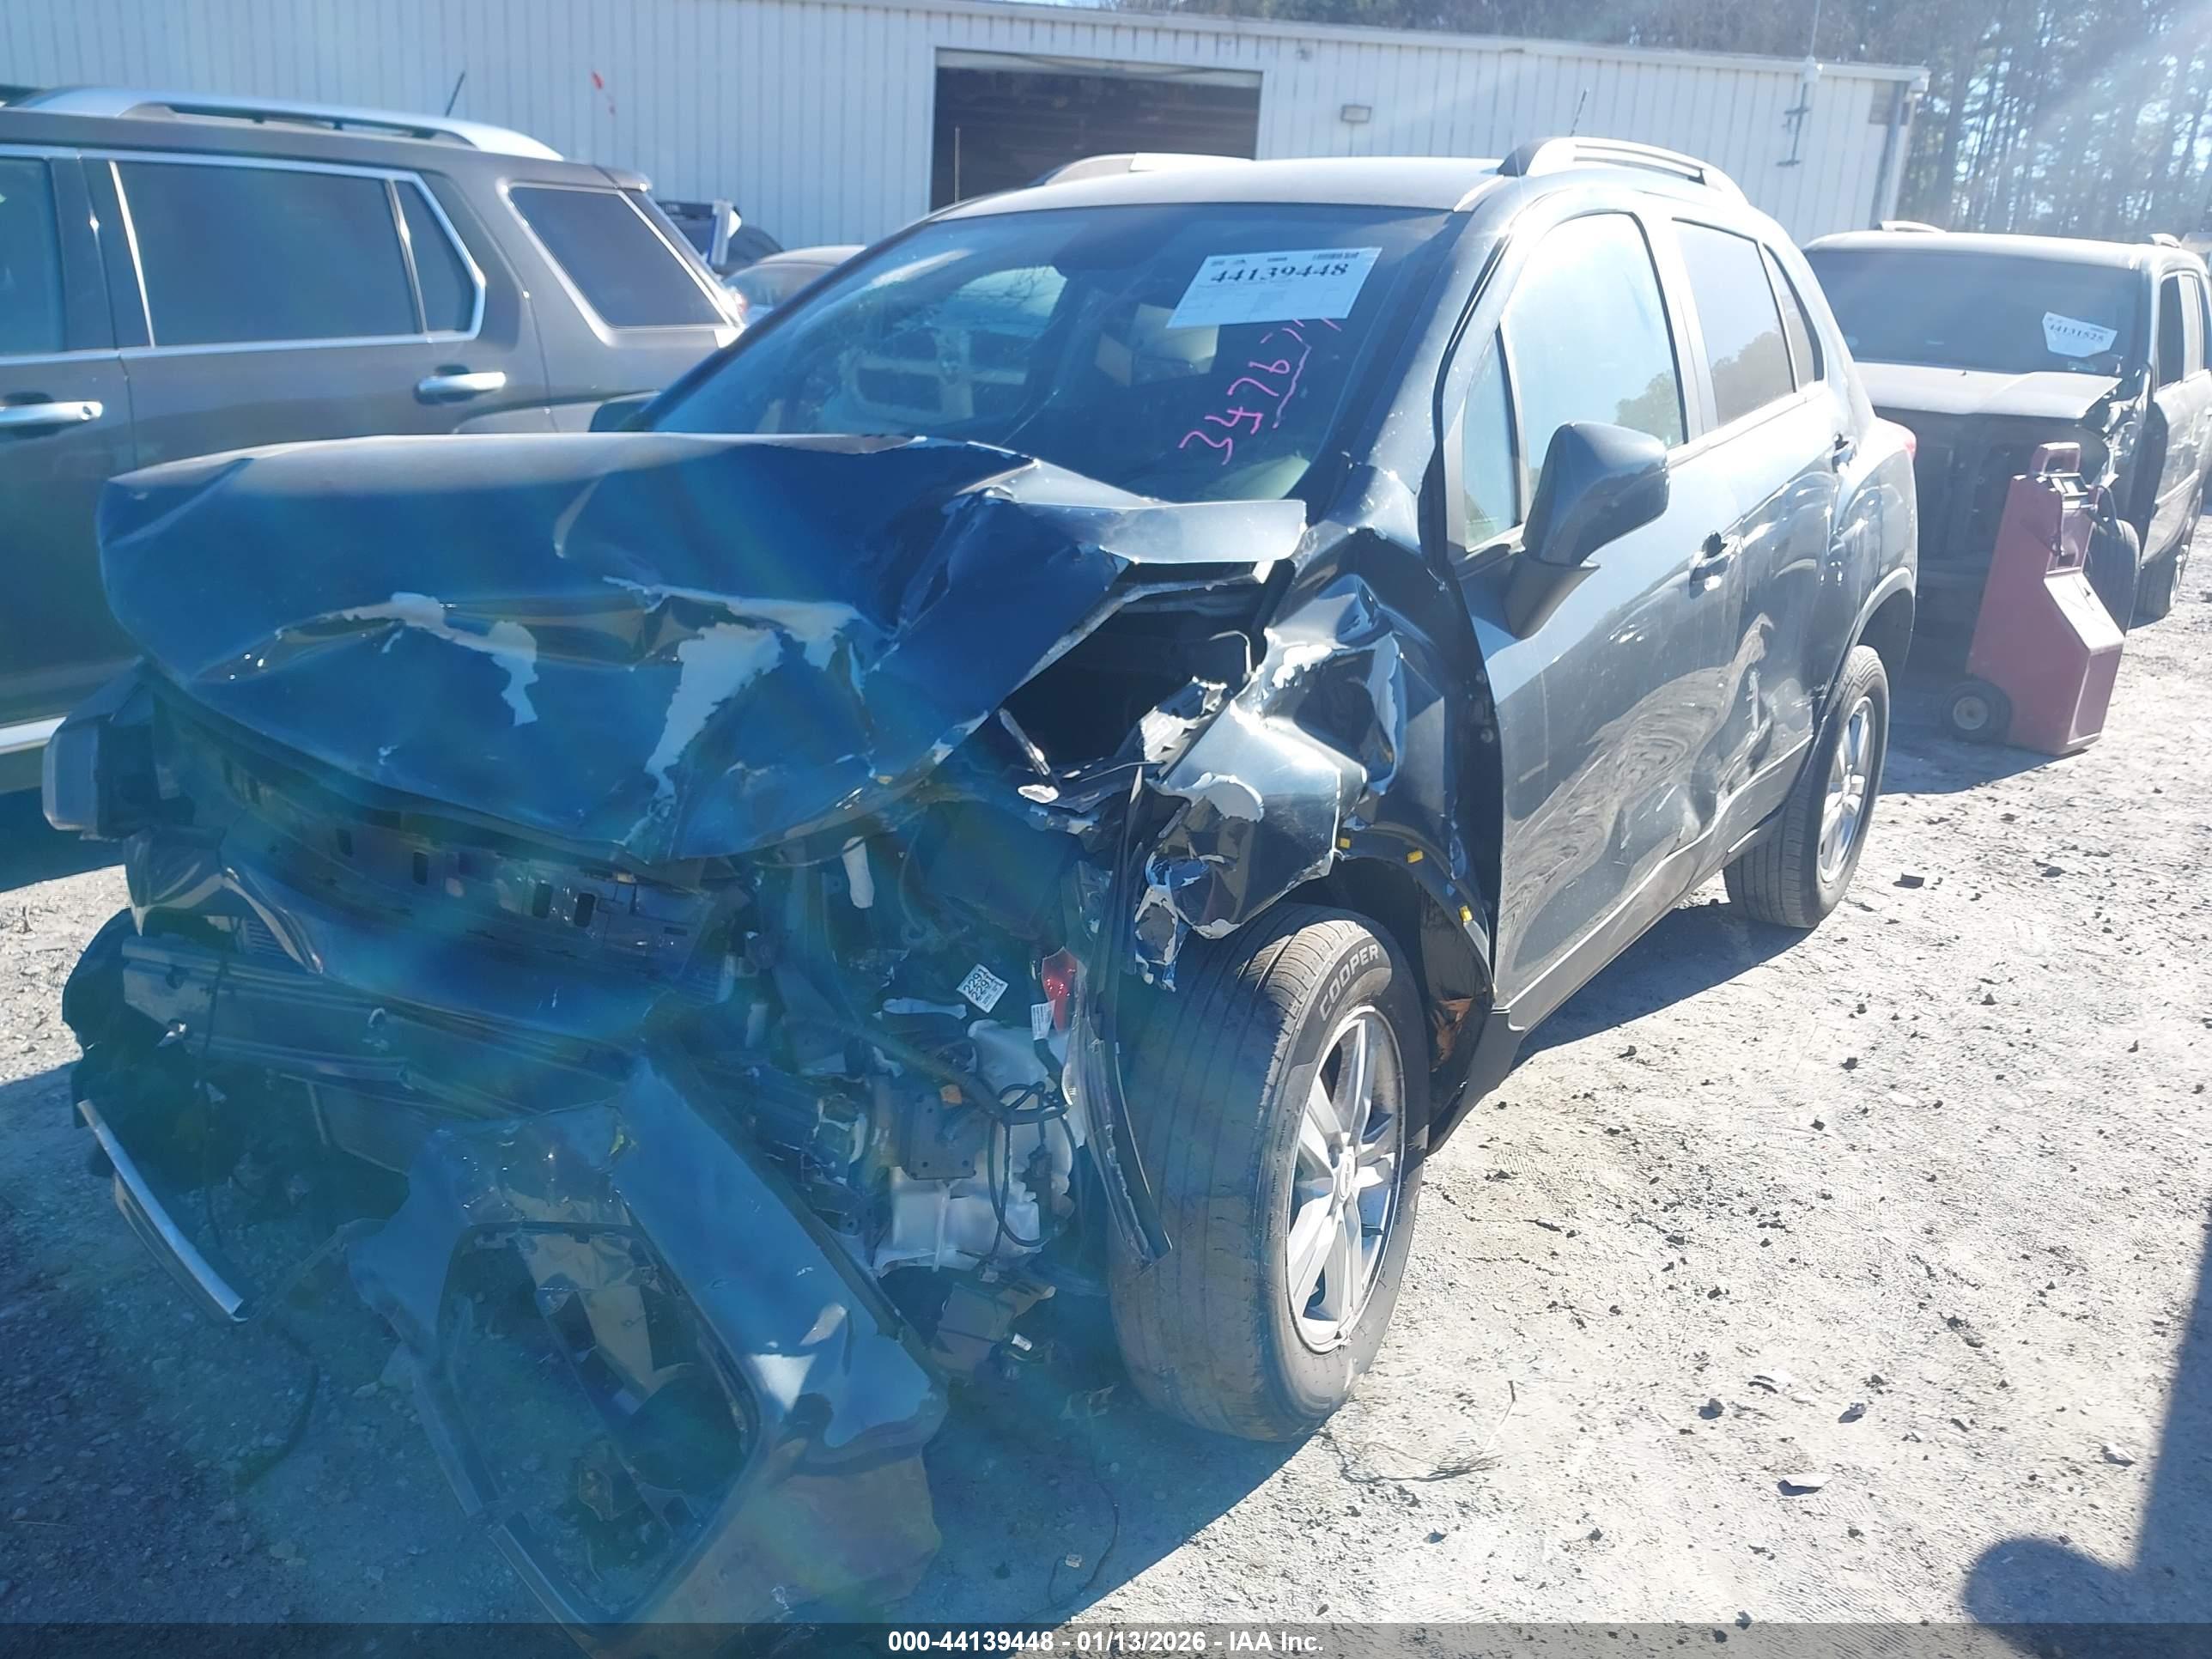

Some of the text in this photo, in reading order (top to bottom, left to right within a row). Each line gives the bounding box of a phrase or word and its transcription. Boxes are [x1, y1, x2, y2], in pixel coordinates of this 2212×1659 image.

[1211, 262, 1349, 283] 44139448
[963, 968, 988, 994] 2291
[970, 975, 995, 1001] 2291
[1319, 944, 1379, 1022] COOPER
